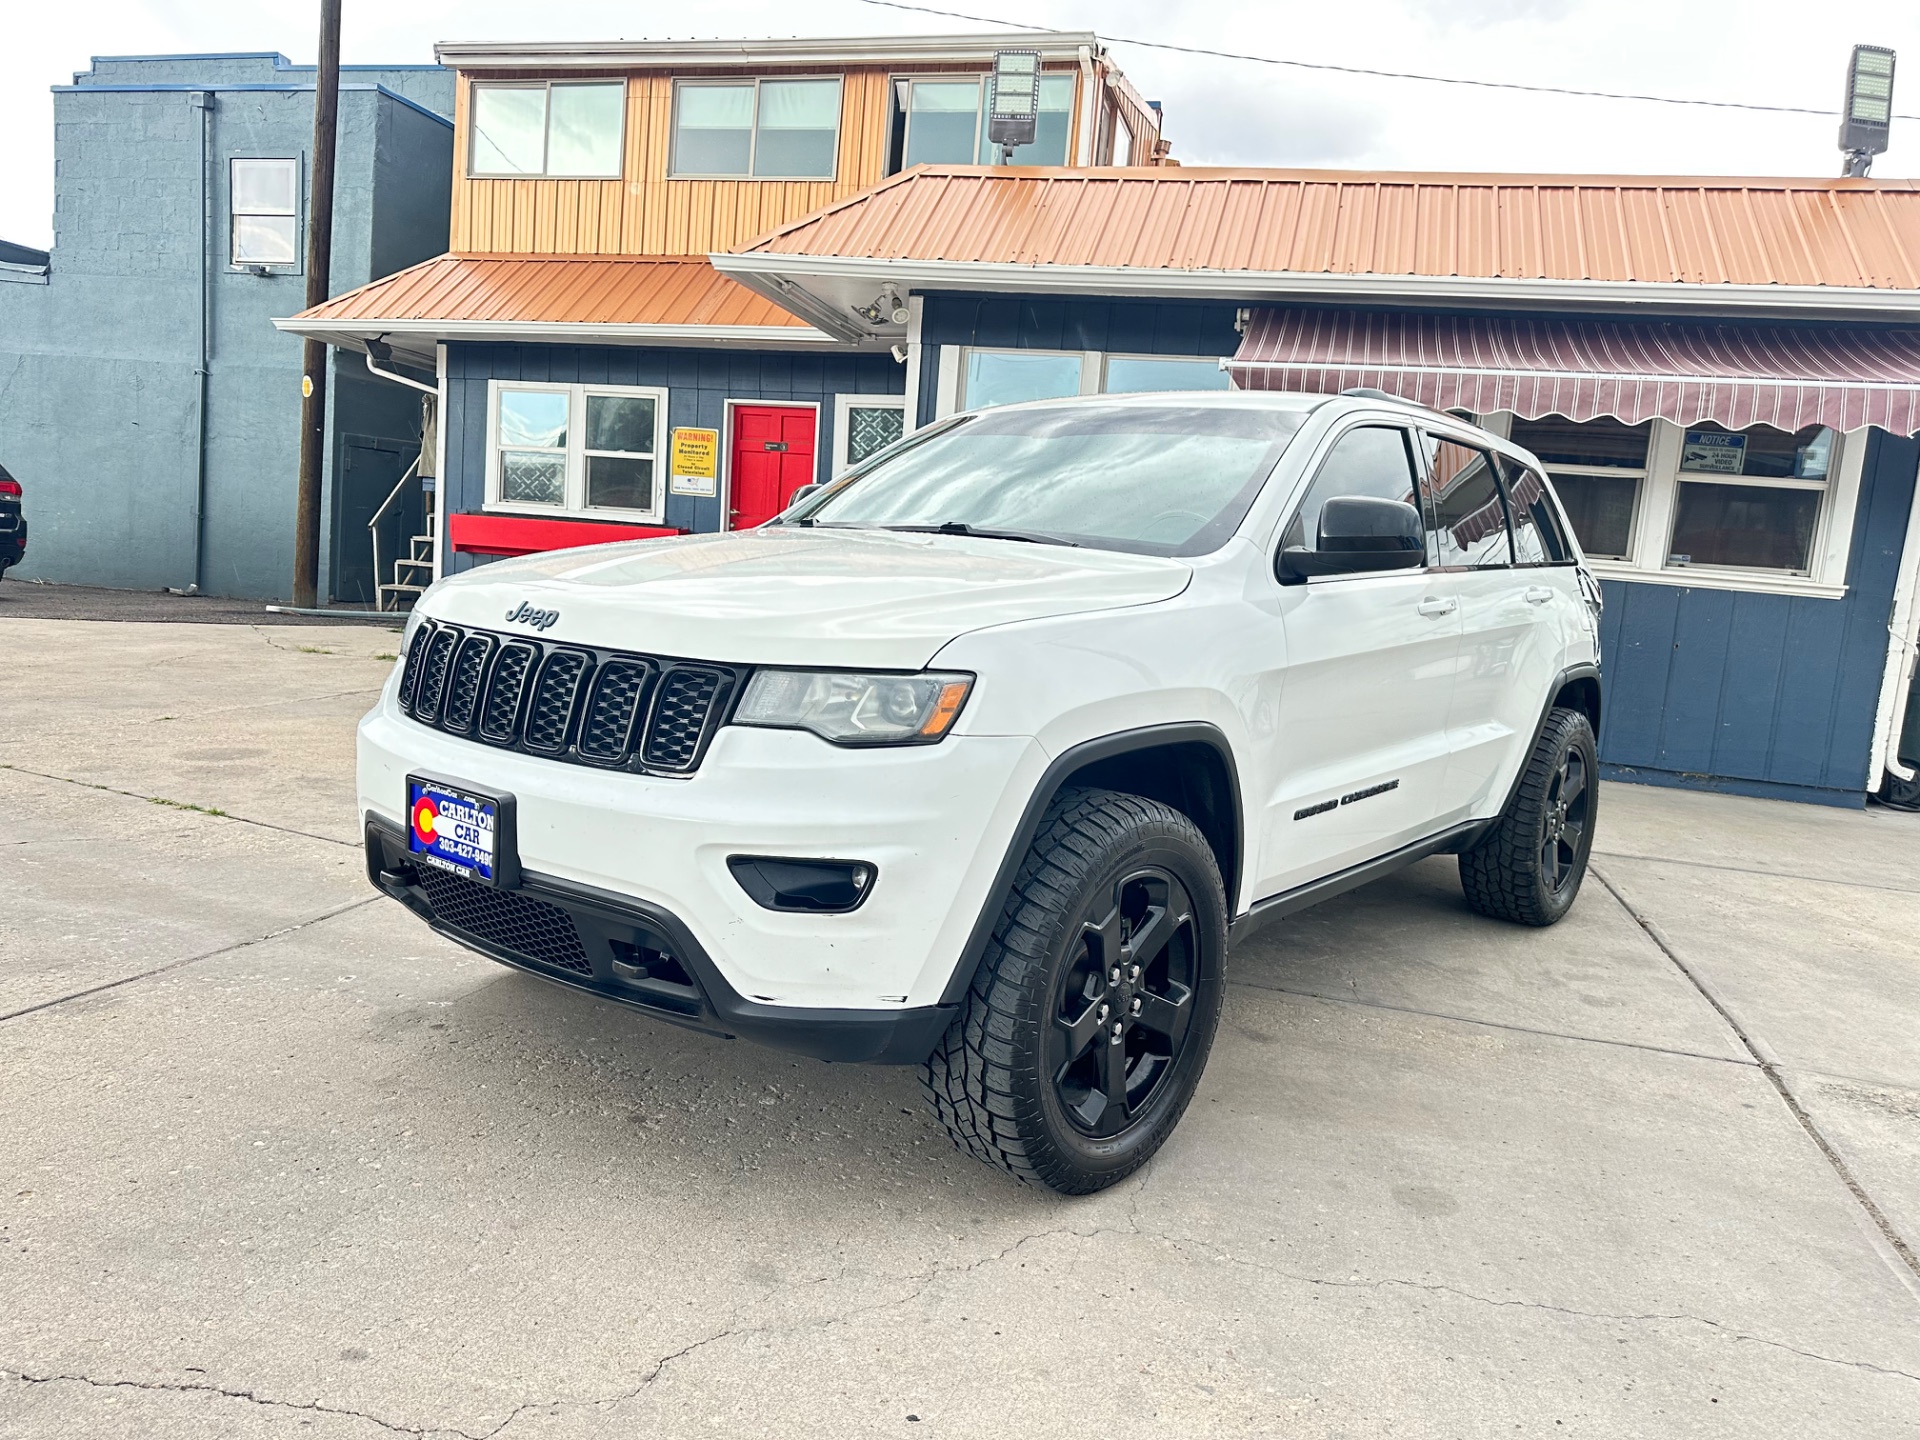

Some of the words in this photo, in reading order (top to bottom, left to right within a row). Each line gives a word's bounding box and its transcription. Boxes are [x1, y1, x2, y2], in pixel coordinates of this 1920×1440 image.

[677, 432, 713, 442] WARNING!
[1699, 435, 1731, 445] NOTICE
[505, 600, 560, 632] Jeep
[439, 800, 494, 831] CARLTON
[454, 823, 480, 845] CAR
